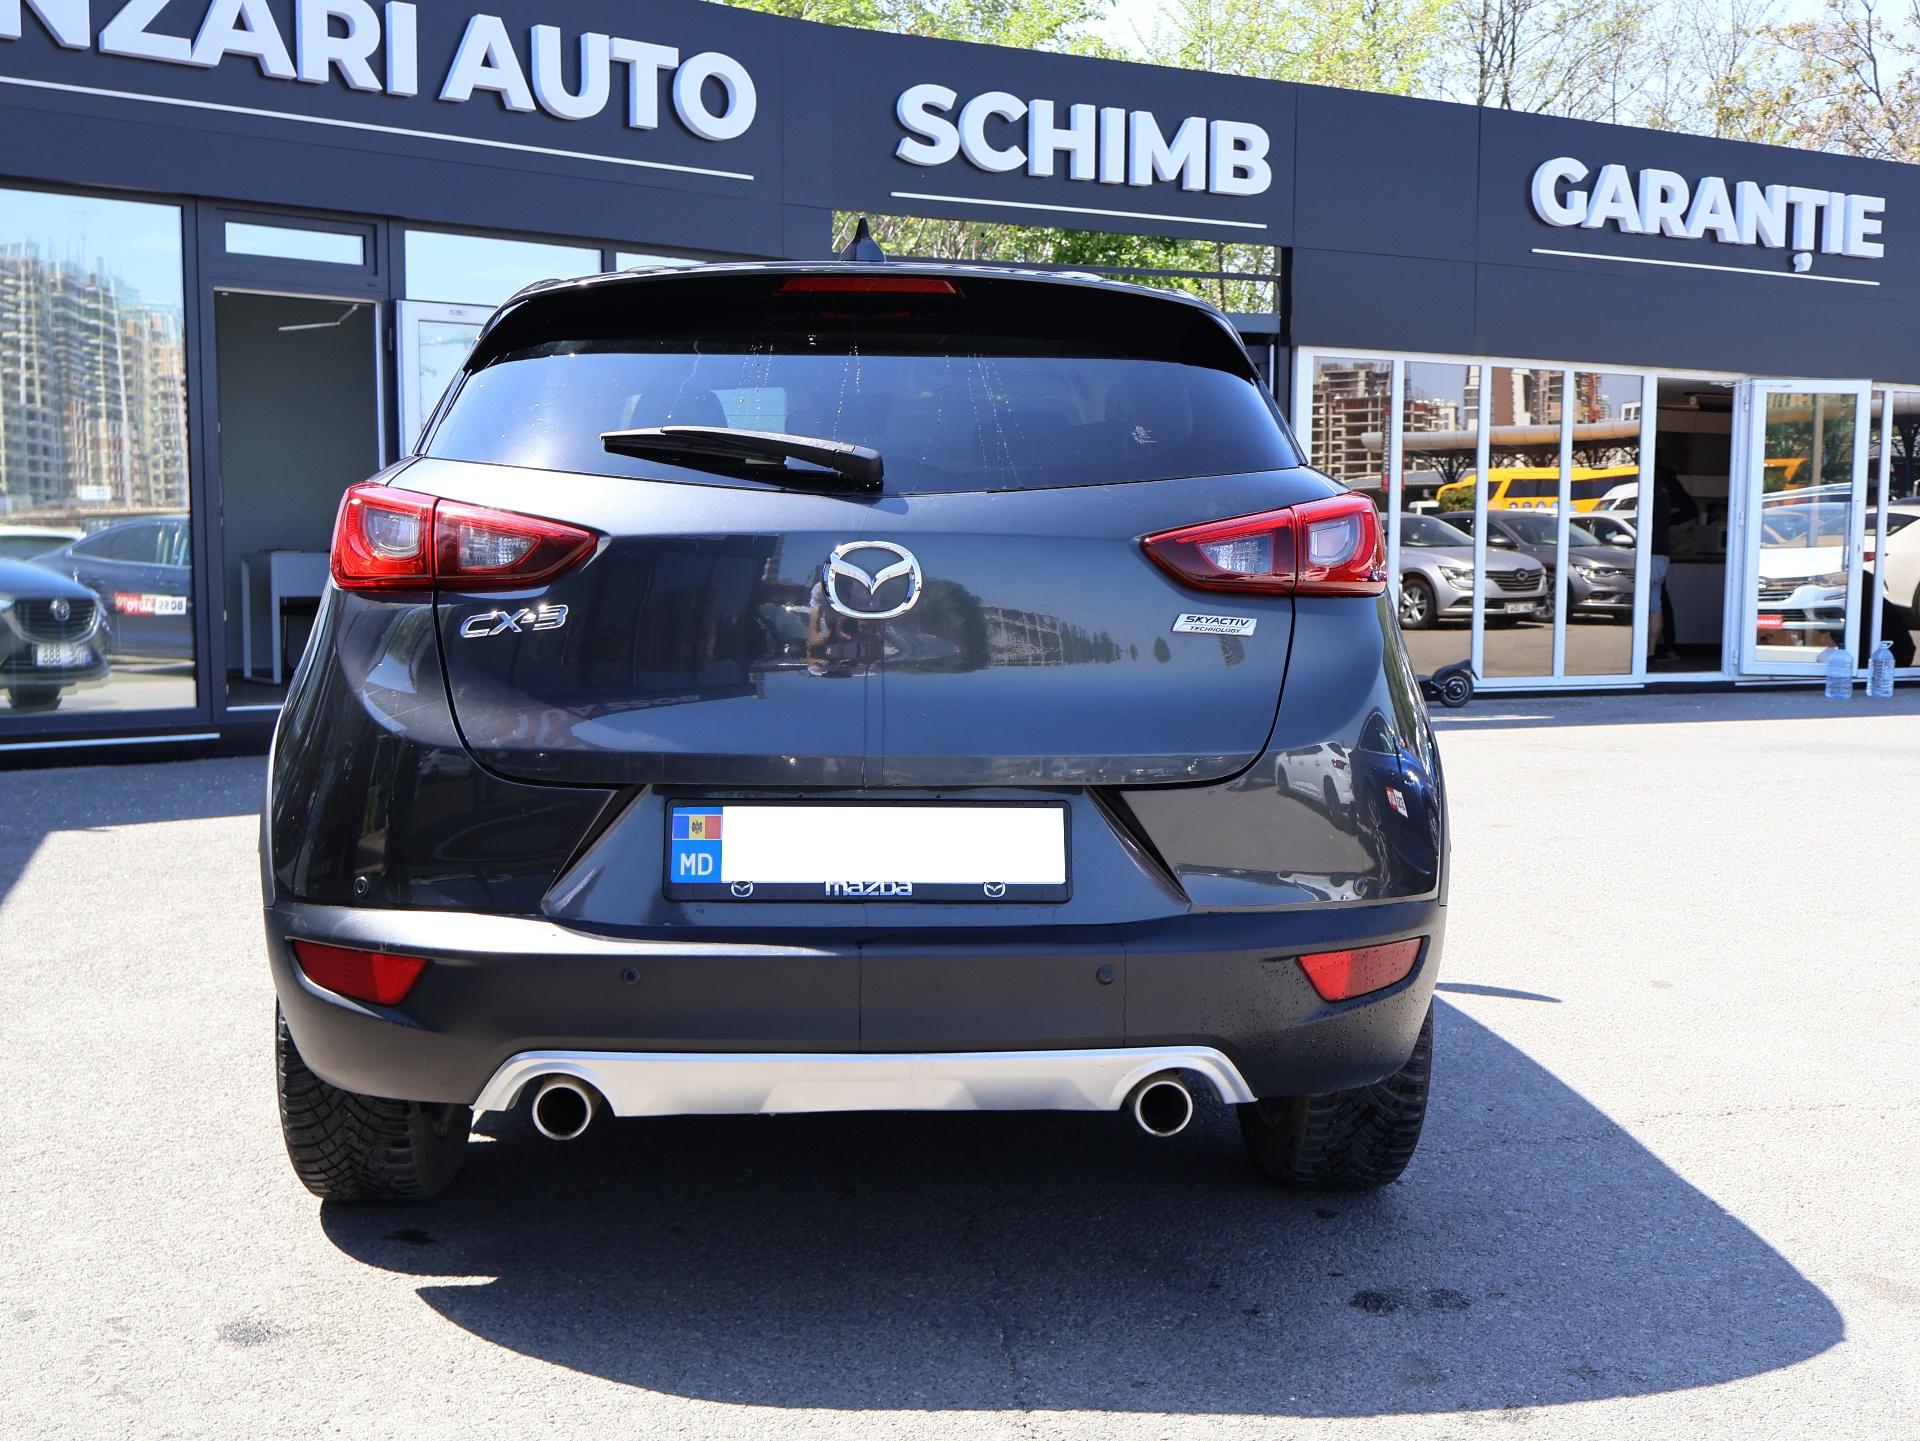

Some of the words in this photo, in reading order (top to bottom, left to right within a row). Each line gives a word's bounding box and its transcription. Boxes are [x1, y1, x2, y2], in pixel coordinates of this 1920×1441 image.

[439, 14, 757, 141] AUTO
[895, 84, 1272, 197] SCHIMB
[1531, 156, 1887, 273] GARANȚIE
[460, 604, 569, 638] CX-3
[1184, 616, 1249, 625] SKYACTIV
[680, 853, 713, 877] MD
